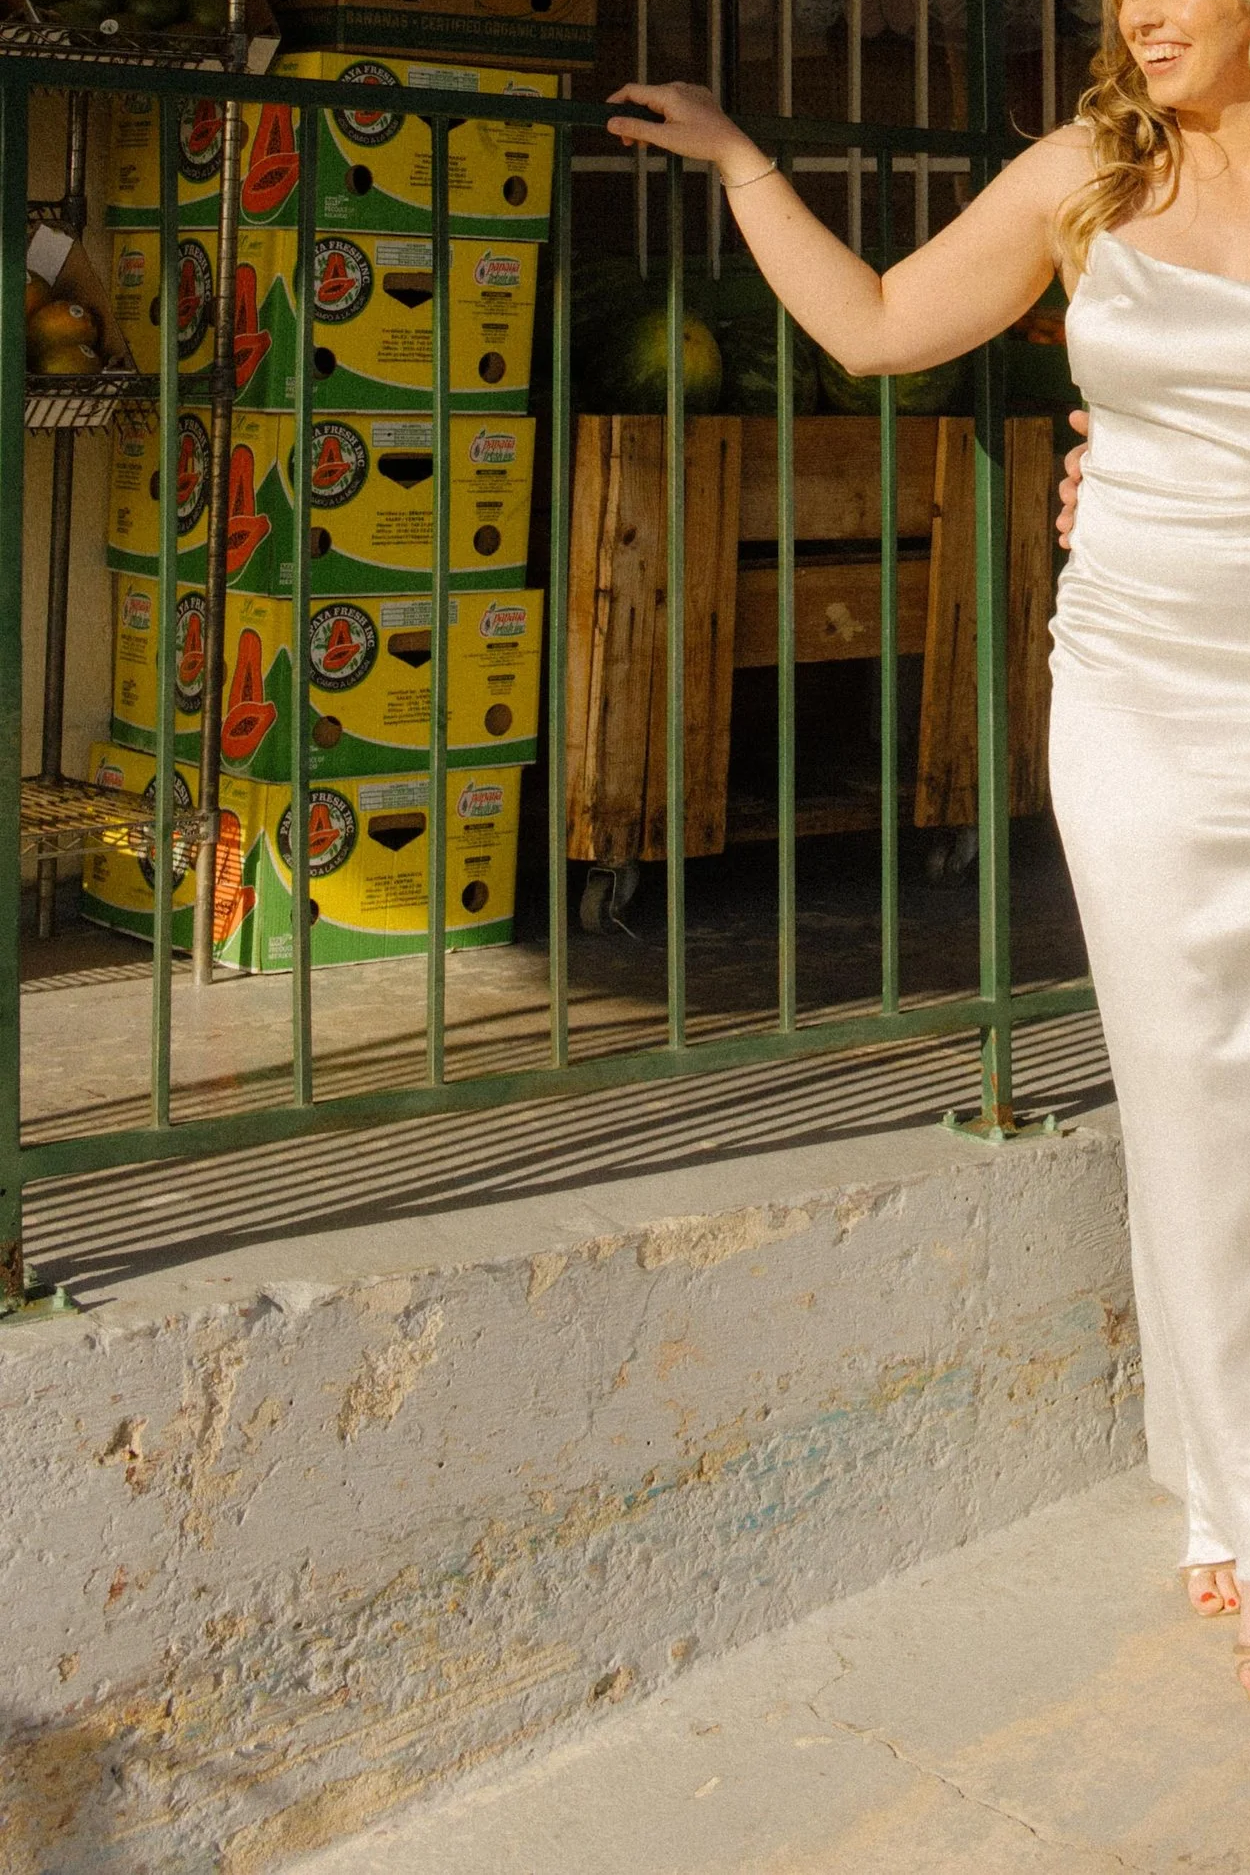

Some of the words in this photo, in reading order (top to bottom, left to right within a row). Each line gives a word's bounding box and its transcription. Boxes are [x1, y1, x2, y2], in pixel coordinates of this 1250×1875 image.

[346, 10, 409, 29] BANANAS
[363, 65, 396, 86] FRESH
[328, 241, 363, 262] FRESH
[324, 425, 358, 445] FRESH
[333, 607, 367, 626] FRESH
[312, 792, 347, 812] FRESH
